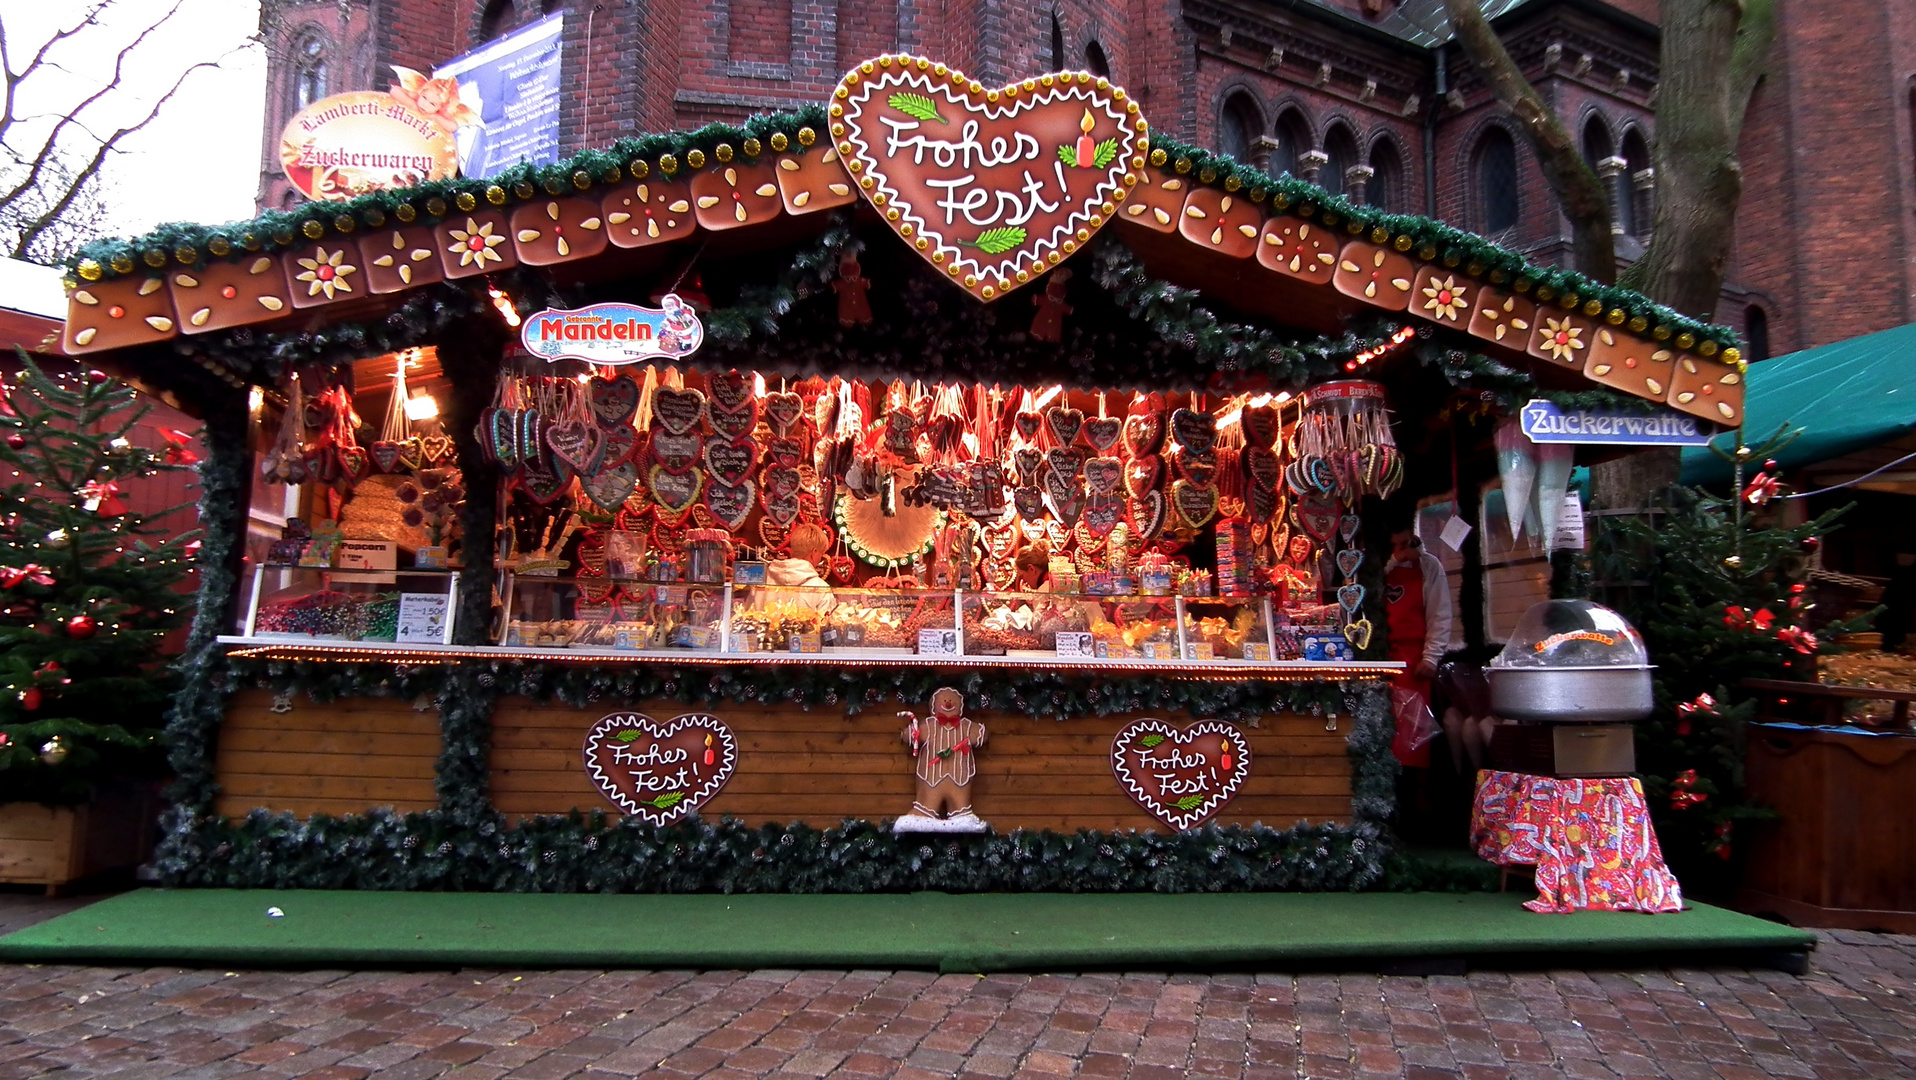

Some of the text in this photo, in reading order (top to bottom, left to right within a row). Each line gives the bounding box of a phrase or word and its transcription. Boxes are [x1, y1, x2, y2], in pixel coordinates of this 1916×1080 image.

[298, 101, 440, 141] Lamberti-Markt
[879, 116, 1040, 169] Frohes
[300, 144, 434, 171] Zuckerwaren
[926, 161, 1072, 226] Fest!
[541, 319, 653, 341] Mandeln
[566, 315, 603, 323] Gebrannte
[1529, 409, 1696, 438] Zuckerwatte
[720, 458, 741, 467] Dich
[341, 542, 387, 551] Popcorn
[400, 626, 409, 637] 4
[426, 626, 444, 637] 5€
[1534, 632, 1614, 653] Zuckerwatte
[606, 743, 688, 766] Frohes
[1132, 748, 1207, 769] Frohes
[628, 762, 702, 793] Fest!
[1153, 766, 1220, 796] Fest!
